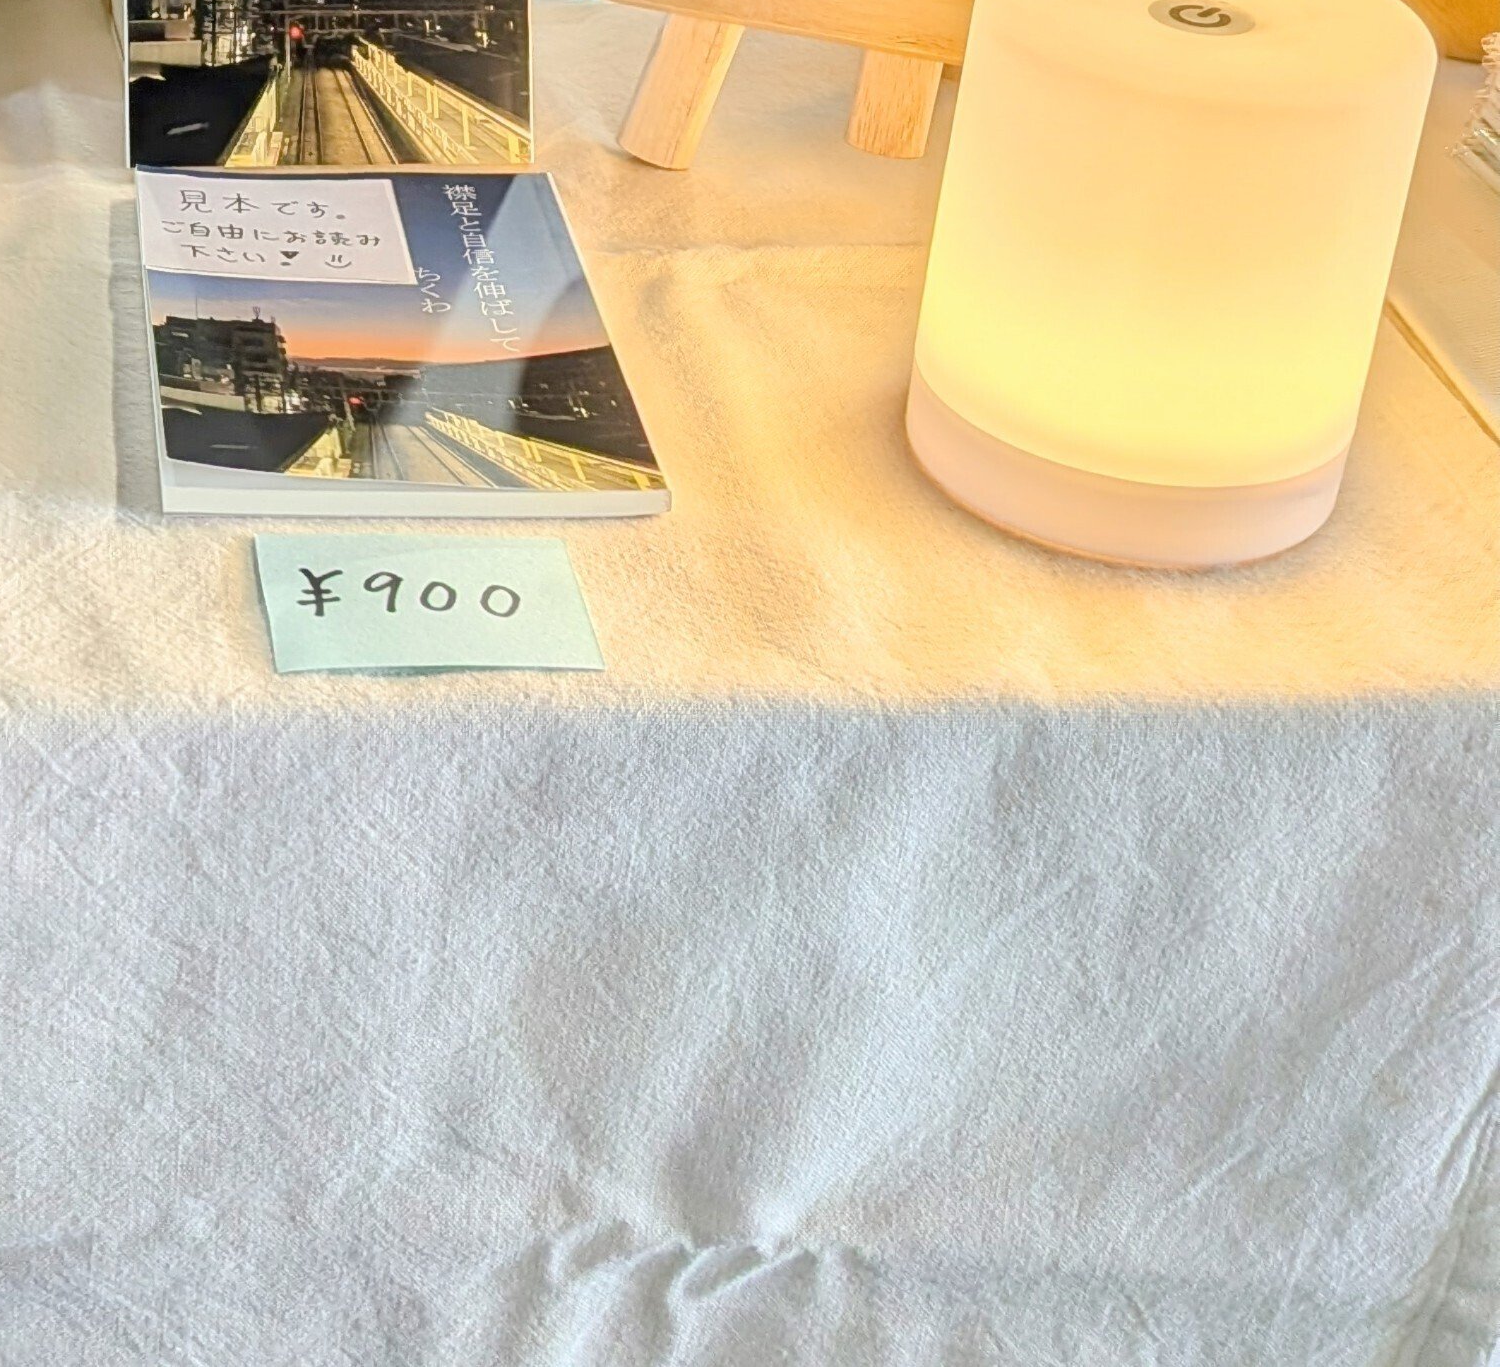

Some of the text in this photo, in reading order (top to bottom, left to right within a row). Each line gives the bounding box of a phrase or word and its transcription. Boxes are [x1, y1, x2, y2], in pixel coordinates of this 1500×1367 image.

[180, 188, 346, 220] 見本です。
[161, 221, 381, 249] ご自由にお読み
[441, 183, 522, 353] 襟足と自信を伸ばして
[414, 265, 452, 314] ちくわ
